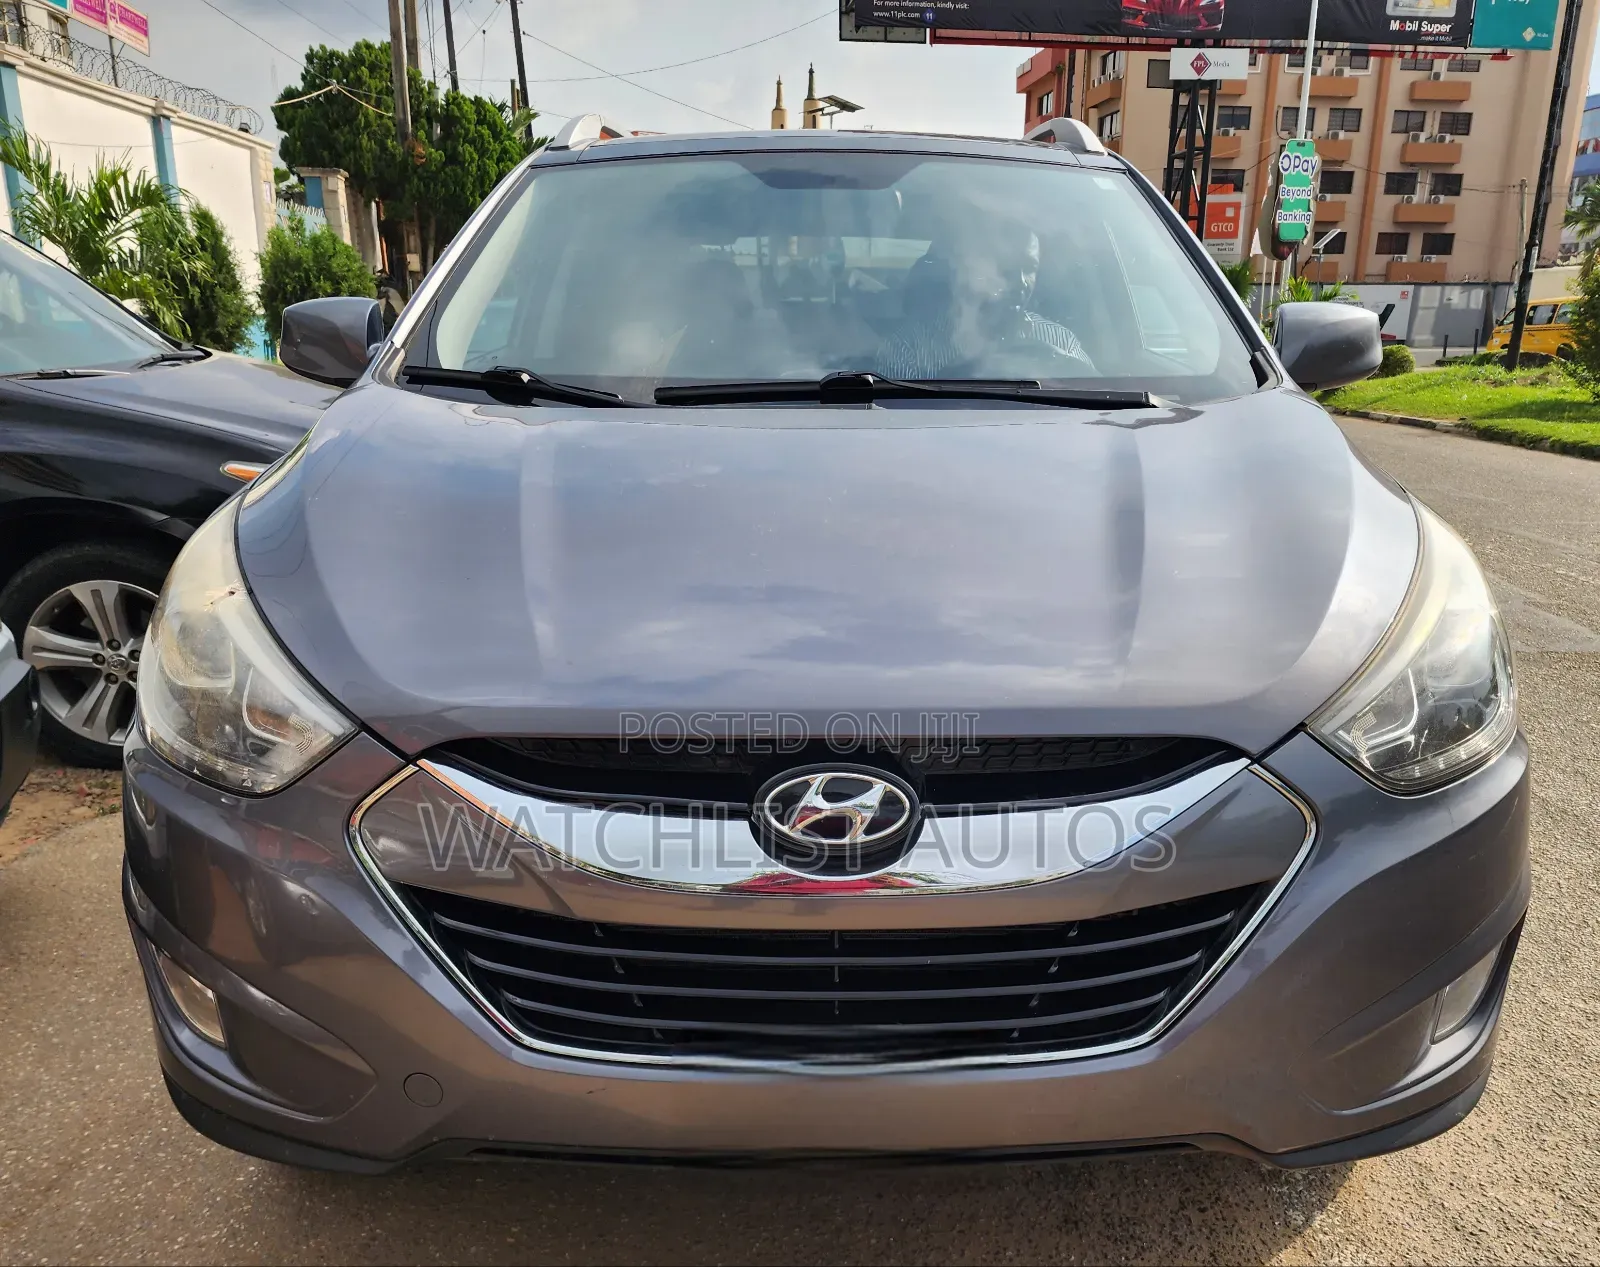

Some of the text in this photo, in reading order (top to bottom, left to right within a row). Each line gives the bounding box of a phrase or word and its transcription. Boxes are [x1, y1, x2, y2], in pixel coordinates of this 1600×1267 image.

[901, 0, 936, 9] information,
[937, 1, 955, 10] kindly
[873, 10, 920, 19] www.11plc.com
[1389, 19, 1452, 34] Mobil Super
[1280, 153, 1318, 177] OPay
[1280, 186, 1312, 201] Beyond
[1277, 208, 1312, 225] Banking
[1210, 222, 1234, 233] GTCO
